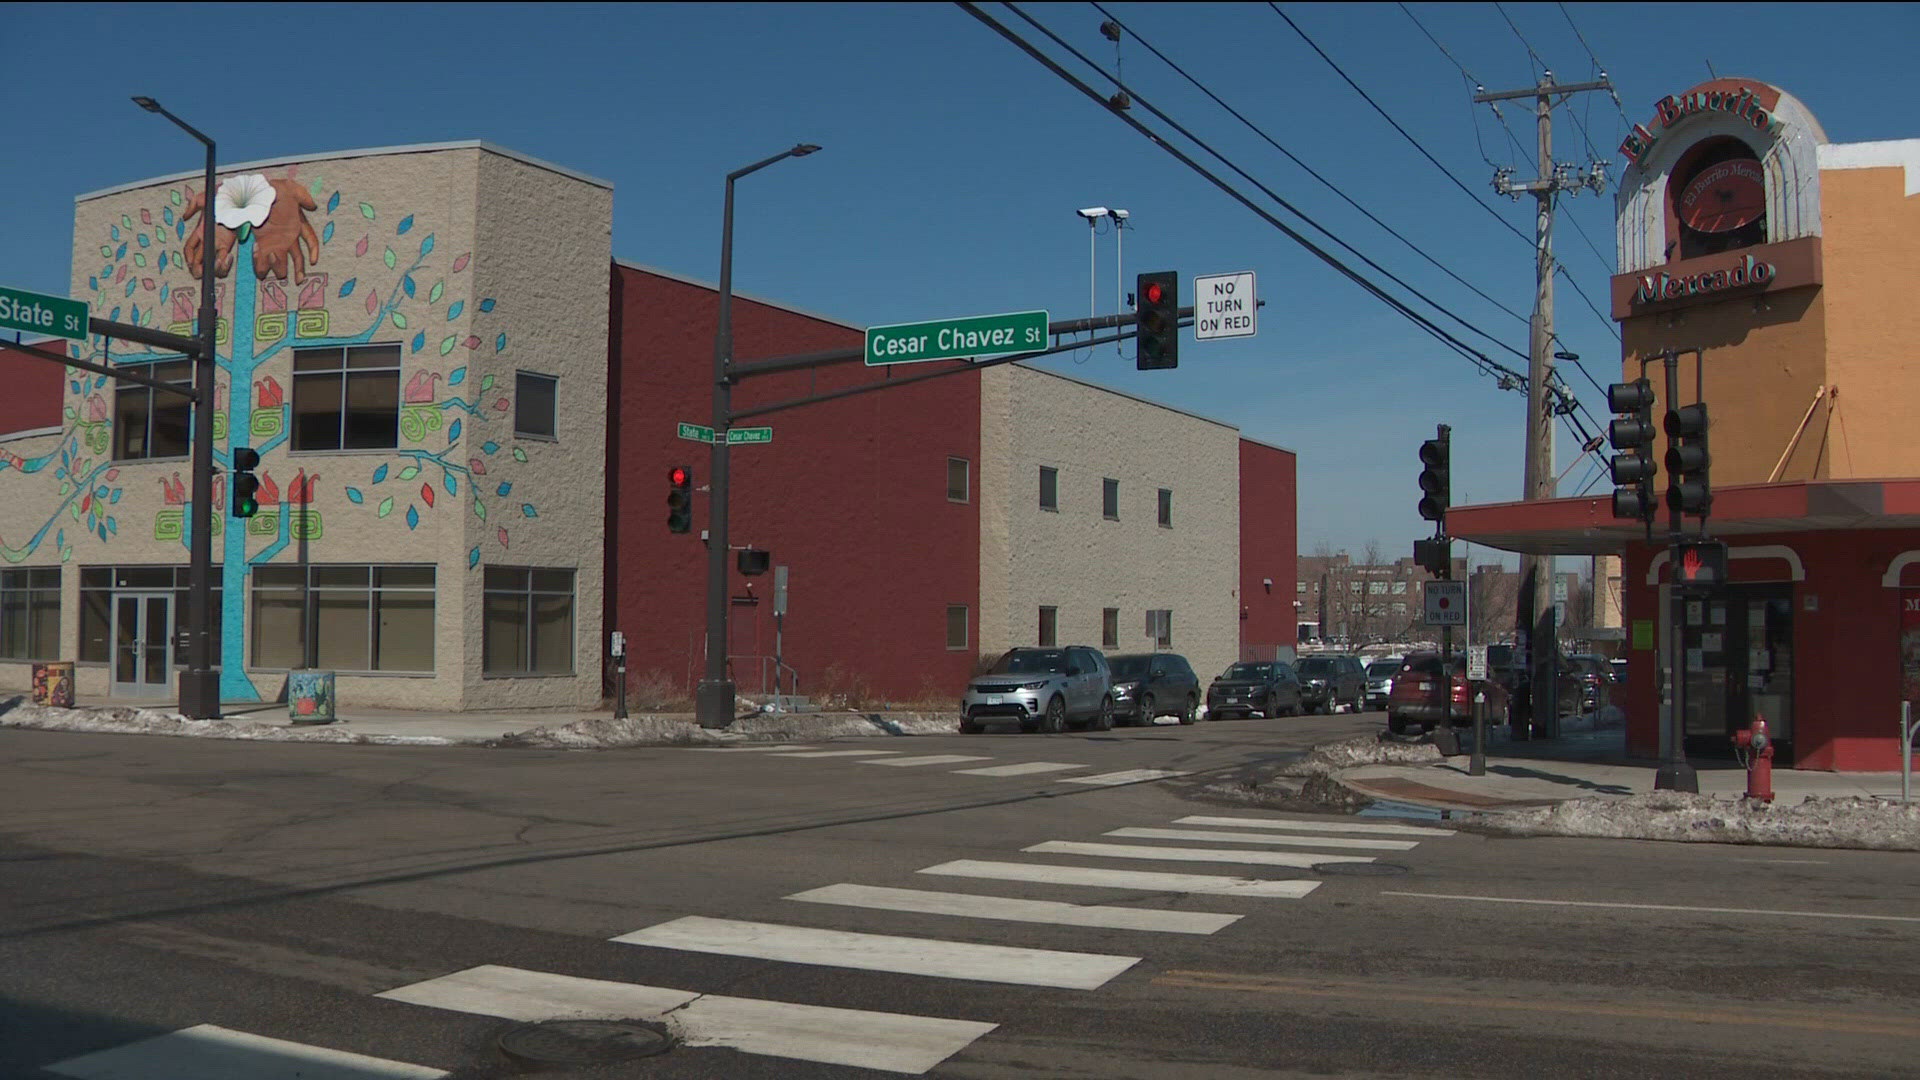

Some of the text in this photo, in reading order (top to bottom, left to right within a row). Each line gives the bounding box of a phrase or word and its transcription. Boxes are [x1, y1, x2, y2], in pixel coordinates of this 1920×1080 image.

[1618, 87, 1775, 165] El Burrito
[1637, 254, 1774, 303] Mercado
[1214, 282, 1235, 296] NO
[0, 296, 79, 331] State St
[1207, 298, 1242, 314] TURN
[1200, 315, 1250, 331] ON RED
[873, 326, 1041, 357] Cesar Chavez St
[1427, 585, 1462, 594] NO TURN
[1430, 611, 1460, 621] ON RED
